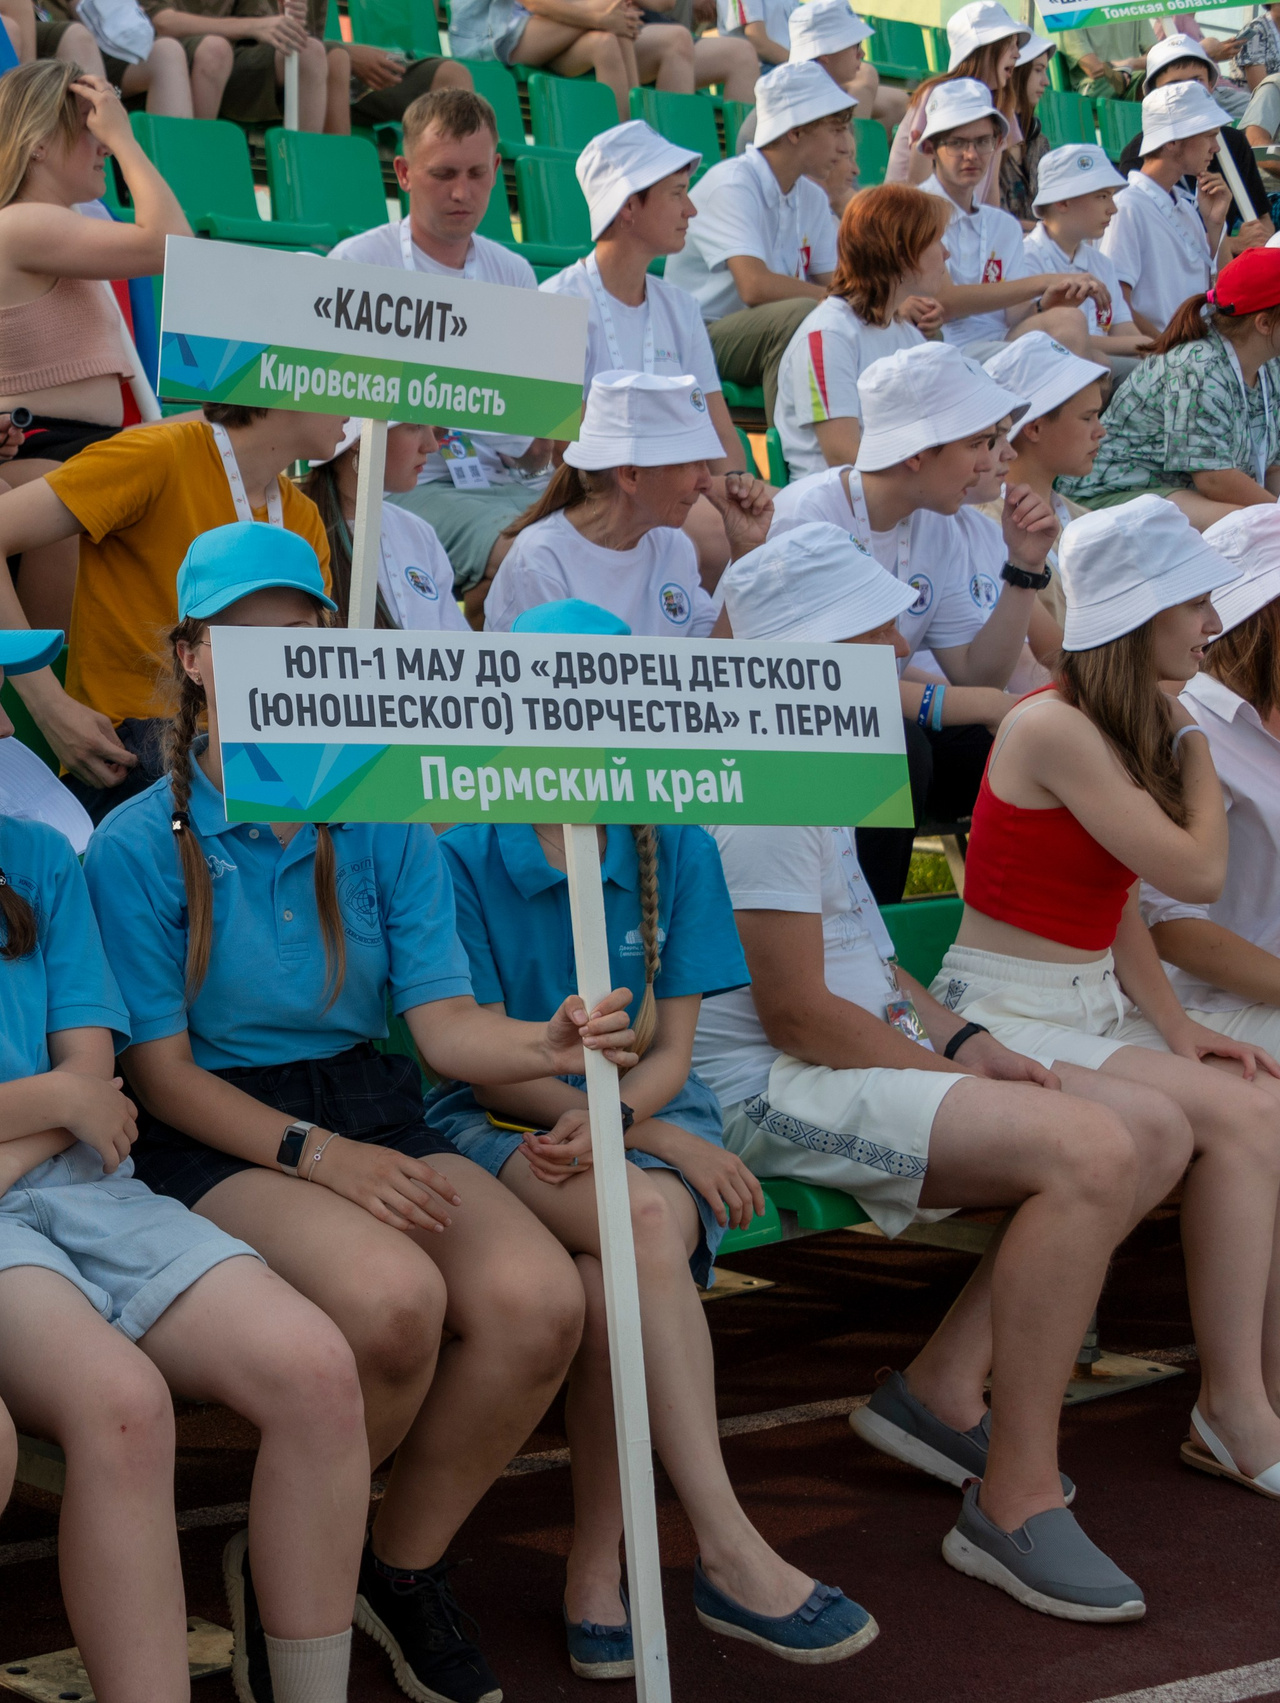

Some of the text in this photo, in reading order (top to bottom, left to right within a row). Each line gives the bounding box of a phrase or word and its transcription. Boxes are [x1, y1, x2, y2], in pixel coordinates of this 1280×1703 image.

[1101, 2, 1164, 19] Томская
[313, 287, 468, 343] «КАССИТ»
[259, 353, 506, 416] Кировская область
[284, 645, 842, 693] ЮГП-1 МАУ ДО «ДВОРЕЦ ДЕТСКОГО
[249, 687, 880, 738] (ЮНОШЕСКОГО) ТВОРЧЕСТВА» г. ПЕРМИ
[420, 756, 744, 813] Пермский край
